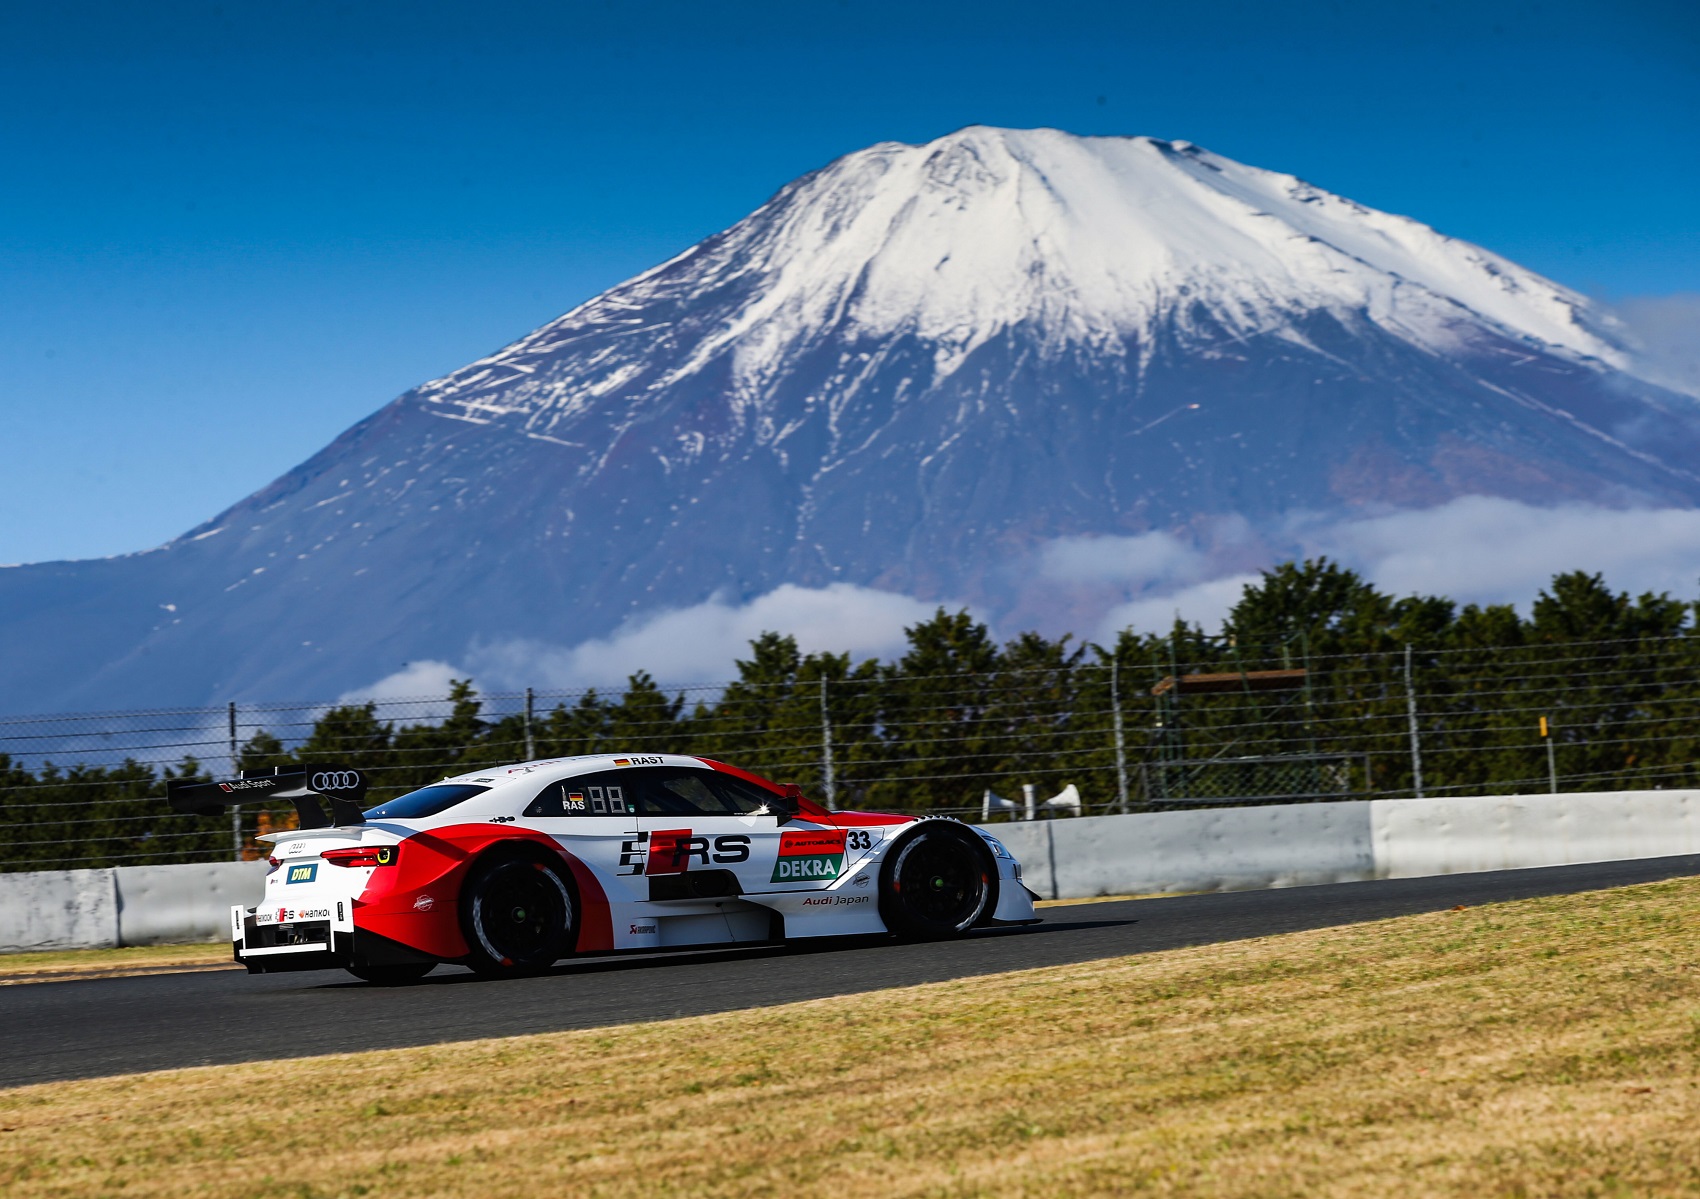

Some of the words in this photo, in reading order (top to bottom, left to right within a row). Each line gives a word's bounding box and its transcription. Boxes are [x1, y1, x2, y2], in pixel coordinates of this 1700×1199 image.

[630, 756, 664, 765] RAST
[562, 800, 585, 810] RAS
[794, 839, 842, 847] AUTOBACS
[848, 831, 871, 850] 33
[672, 835, 751, 866] RS
[291, 867, 312, 881] DTM
[779, 858, 836, 878] DEKRA
[803, 896, 833, 906] Audi
[834, 895, 869, 906] Japan
